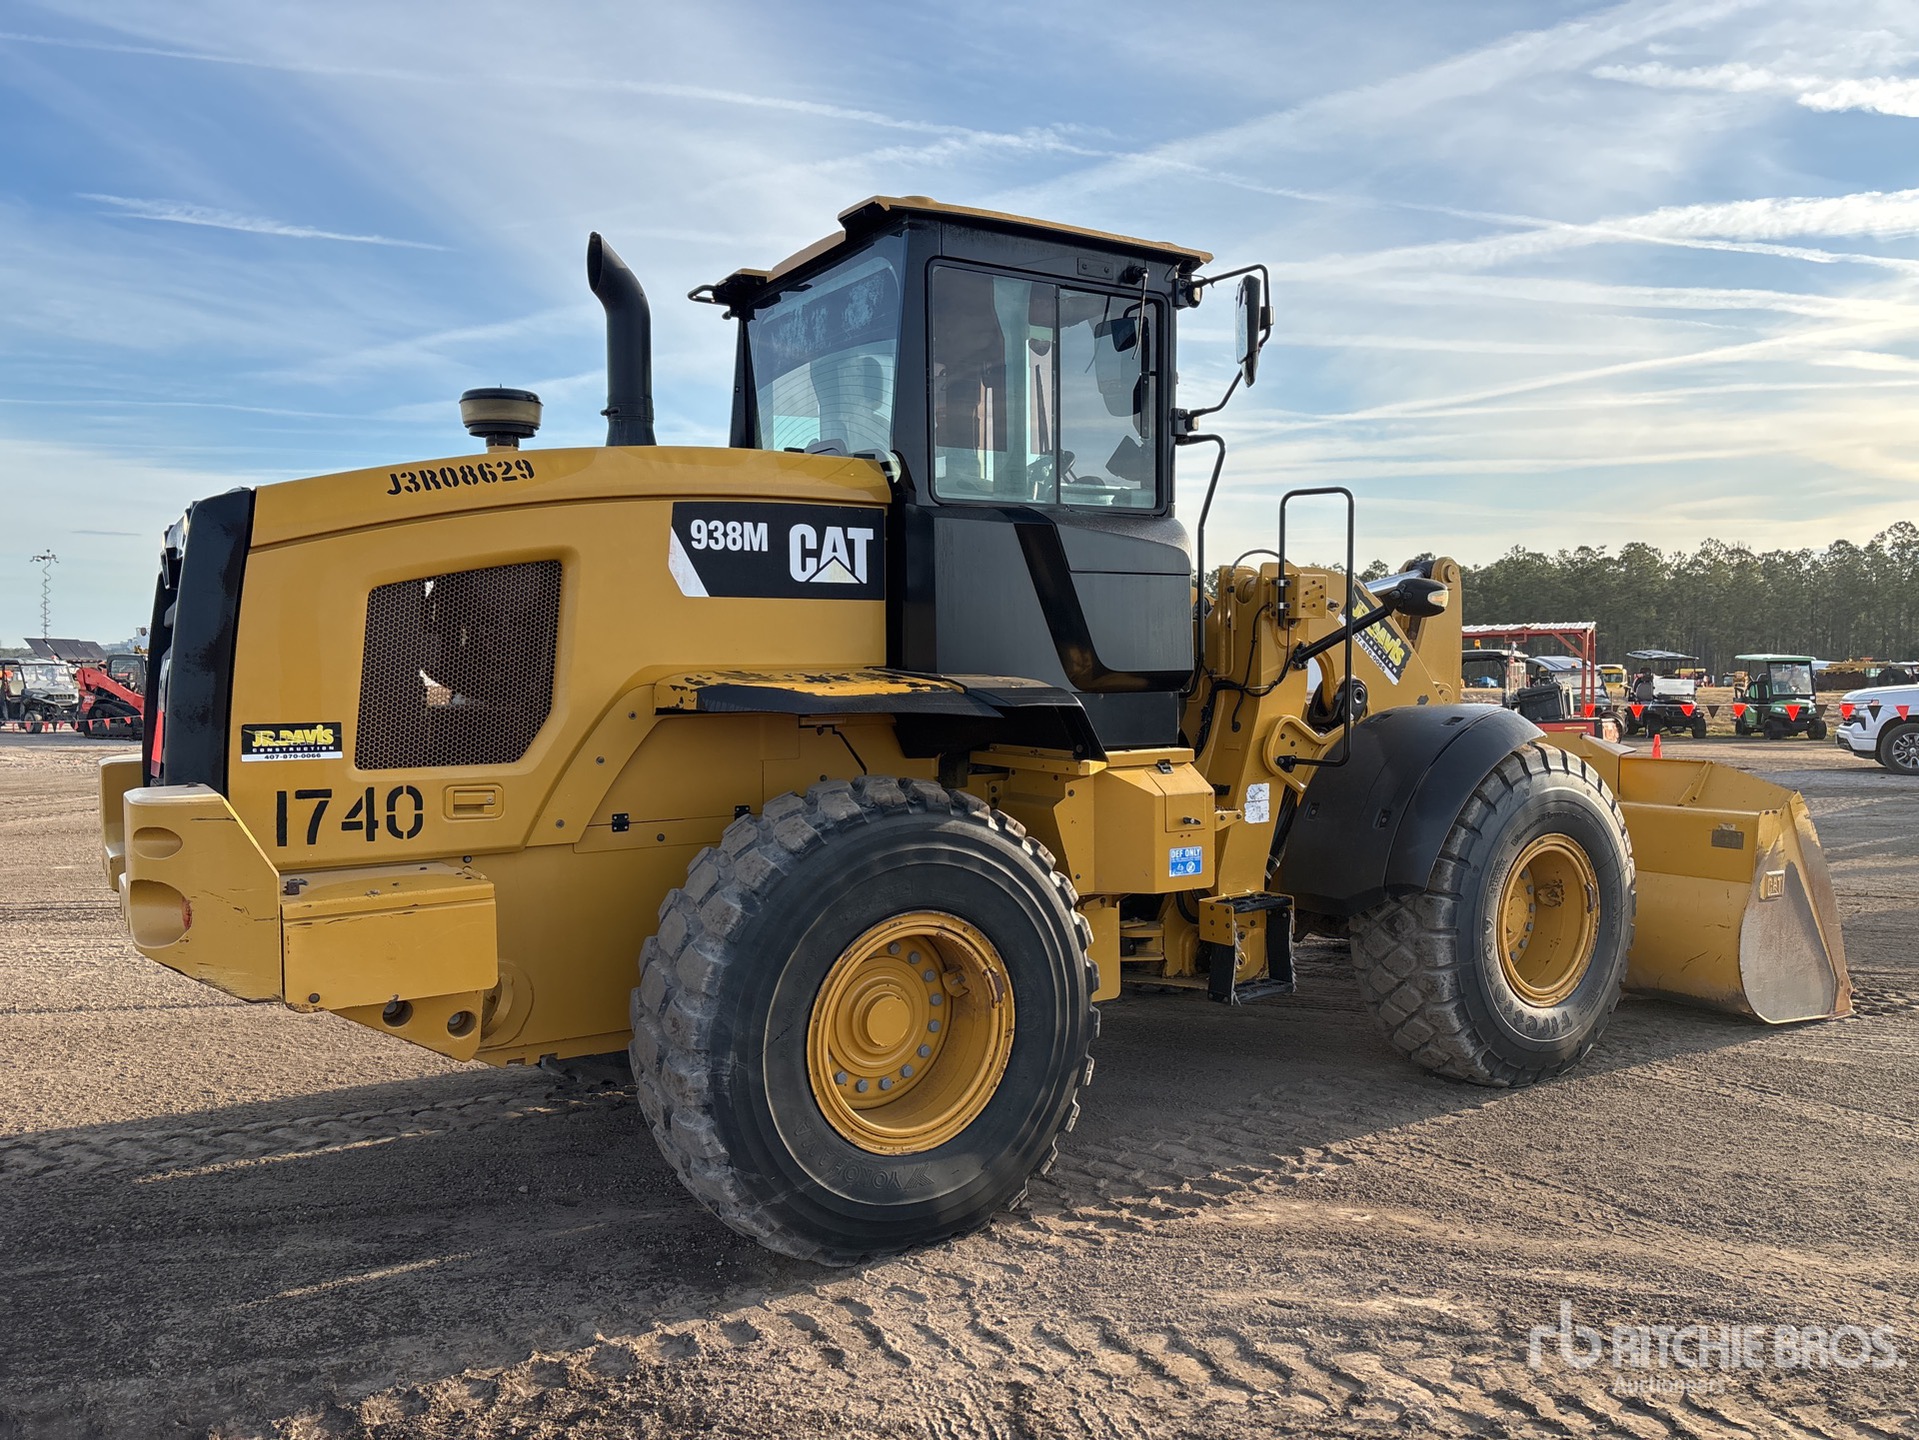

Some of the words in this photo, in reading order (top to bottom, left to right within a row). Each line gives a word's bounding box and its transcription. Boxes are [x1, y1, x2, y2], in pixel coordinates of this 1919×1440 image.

[386, 459, 535, 496] J3R08629
[690, 518, 769, 552] 938M
[788, 523, 874, 585] CAT
[276, 785, 424, 847] 1740
[1170, 849, 1183, 858] DEF
[1184, 848, 1200, 857] ONLY
[794, 1117, 902, 1189] YOKOHAMA
